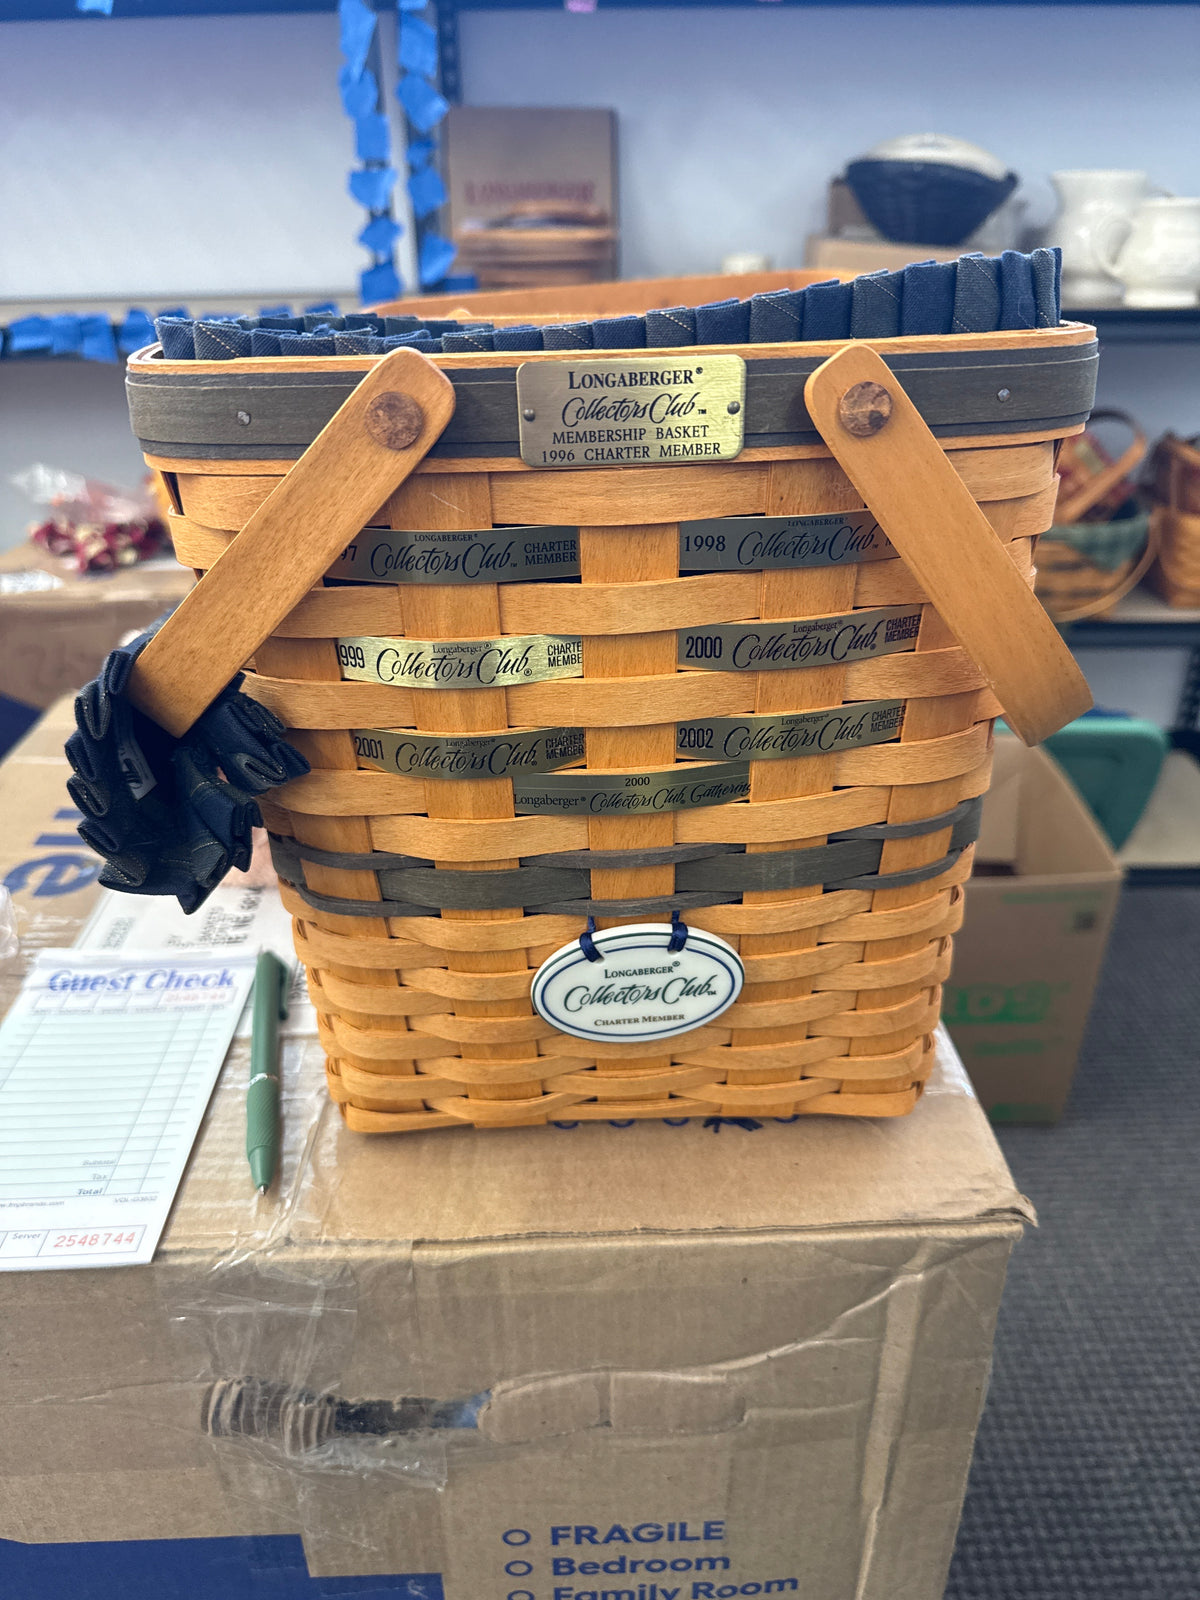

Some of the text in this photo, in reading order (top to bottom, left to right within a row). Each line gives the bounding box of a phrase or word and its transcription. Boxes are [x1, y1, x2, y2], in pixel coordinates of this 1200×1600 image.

[562, 396, 650, 427] Collectors
[552, 425, 709, 445] MEMBERSHIP BASKET
[542, 442, 721, 463] 1996 CHARTER MEMBER
[524, 540, 577, 554] CHARTER
[684, 535, 726, 552] 1998
[737, 529, 828, 566] Collectors
[370, 543, 460, 577] Collectors
[524, 551, 577, 565] MEMBER
[547, 641, 582, 656] CHARTE
[685, 636, 723, 659] 2000
[732, 633, 832, 669] Collectors
[376, 648, 473, 682] Collectors
[548, 653, 582, 668] MEMBE
[871, 705, 906, 723] CHARTER
[545, 733, 584, 749] CHARTER
[678, 727, 714, 749] 2002
[723, 725, 818, 758] Collectors
[354, 736, 384, 760] 2001
[395, 742, 487, 774] Collectors
[546, 744, 584, 760] MEMBER
[625, 777, 650, 787] 2000
[590, 791, 653, 813] Collectors
[48, 968, 236, 992] Guest Check
[564, 983, 662, 1013] Collectors
[77, 1188, 103, 1196] Total
[12, 1232, 41, 1240] Server
[53, 1231, 136, 1249] 2548744
[550, 1520, 725, 1546] FRAGILE
[552, 1554, 731, 1576] Bedroom
[691, 1576, 799, 1600] Room
